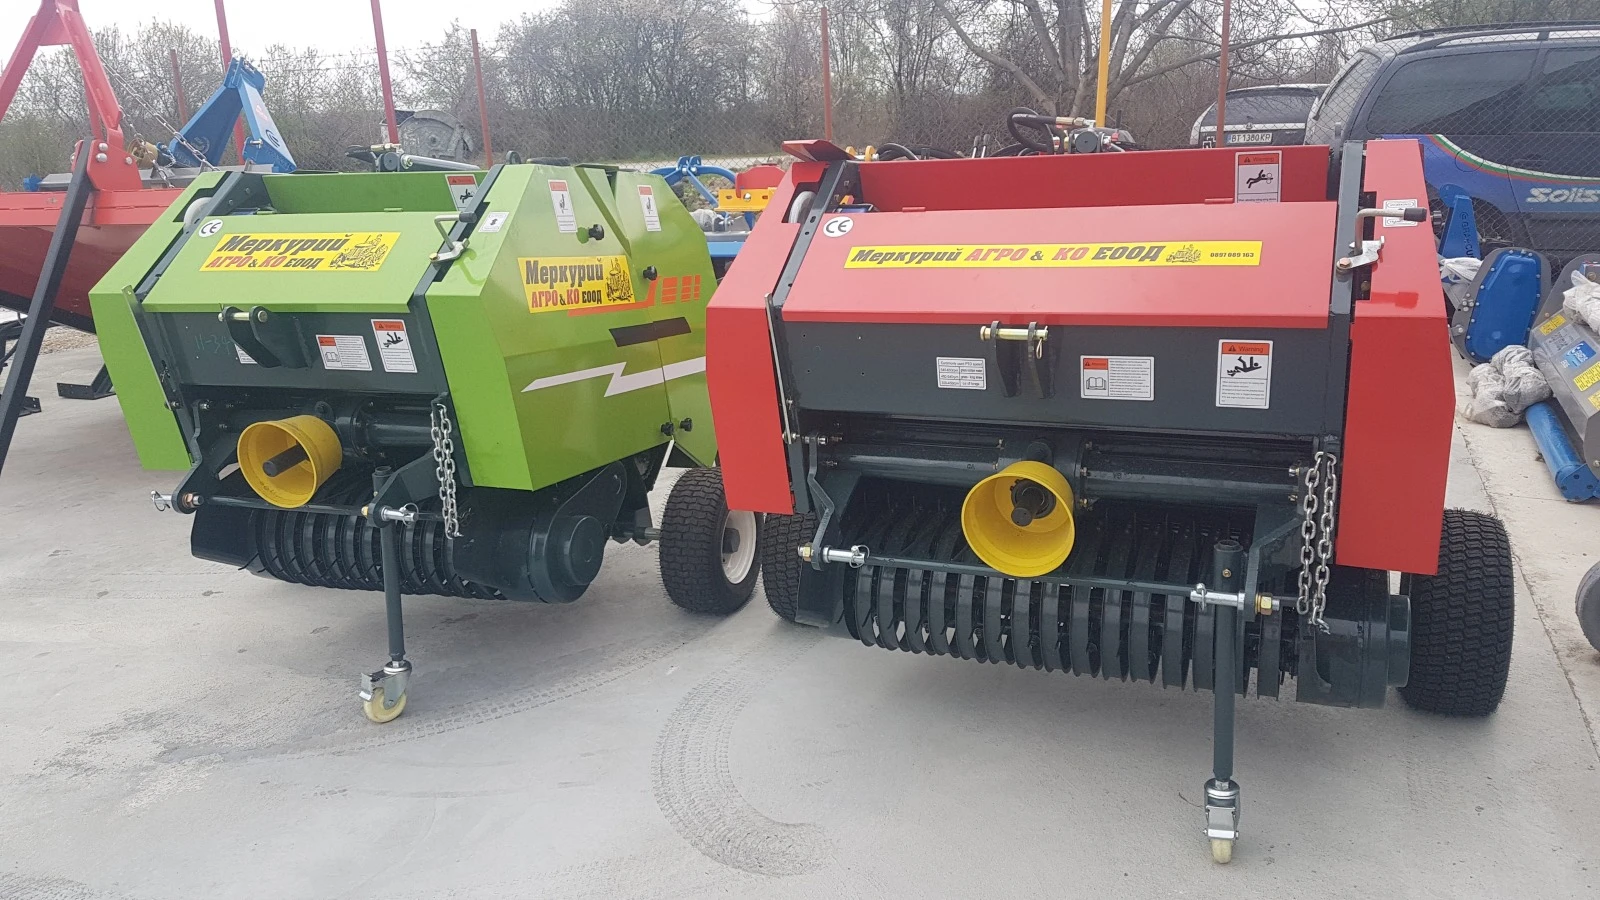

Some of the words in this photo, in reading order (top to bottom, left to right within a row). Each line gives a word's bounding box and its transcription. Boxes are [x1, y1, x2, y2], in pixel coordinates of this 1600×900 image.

[1526, 187, 1600, 203] Solis
[200, 221, 222, 234] CE
[825, 219, 851, 234] CE
[216, 233, 353, 255] Меркурий
[205, 255, 252, 268] АГРО
[248, 258, 258, 268] &
[258, 255, 287, 268] КО
[282, 257, 325, 269] ЕООД
[851, 247, 964, 265] Меркурий
[963, 247, 1030, 262] АГРО
[1030, 250, 1045, 261] &
[1051, 247, 1090, 261] КО
[1091, 245, 1167, 262] ЕООД
[525, 257, 604, 290] Меркурий
[531, 289, 559, 308] АГРО
[559, 293, 567, 306] &
[566, 288, 580, 305] КО
[581, 289, 603, 305] ЕООД
